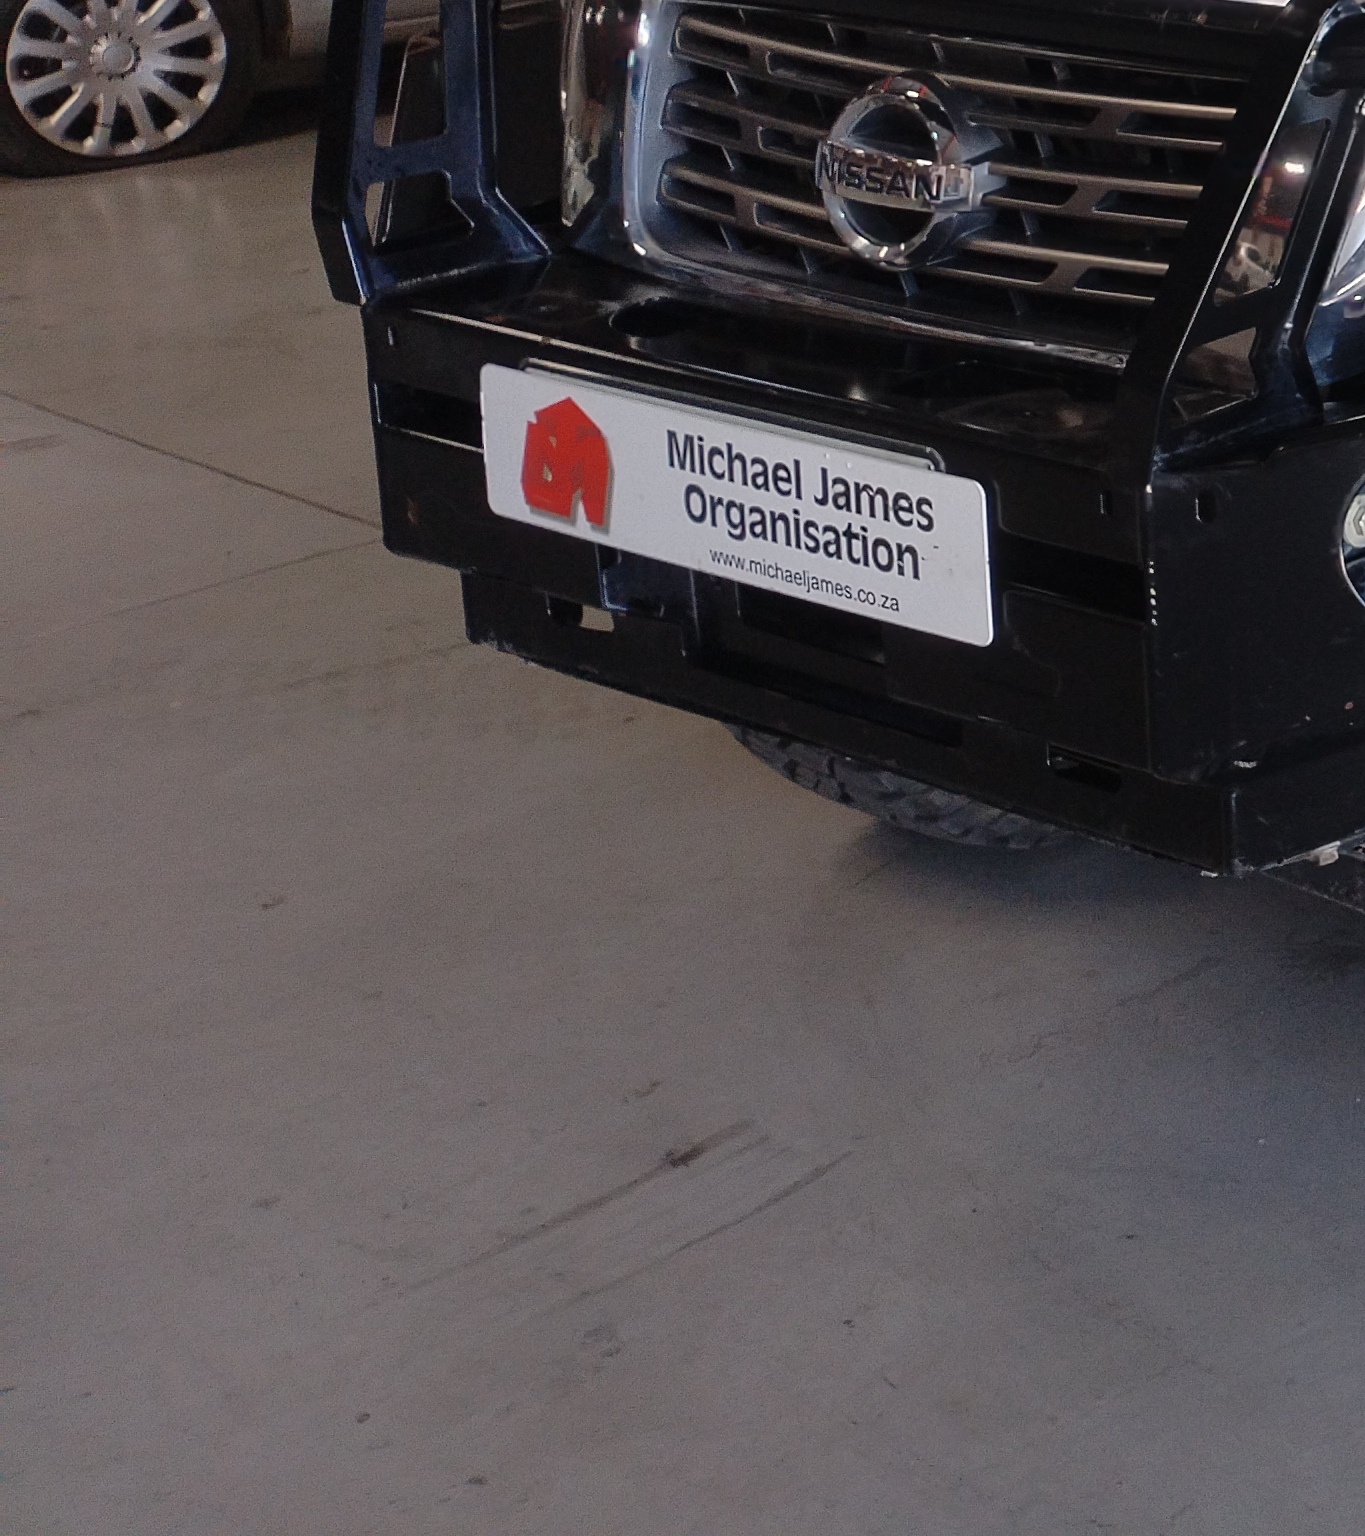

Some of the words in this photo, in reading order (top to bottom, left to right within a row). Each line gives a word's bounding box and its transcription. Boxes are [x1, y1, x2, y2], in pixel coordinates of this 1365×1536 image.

[821, 142, 946, 203] NISSAN
[666, 429, 803, 501] Michael
[813, 466, 935, 533] James
[683, 483, 923, 581] Organisation
[709, 546, 901, 614] www.michaeljames.co.za
